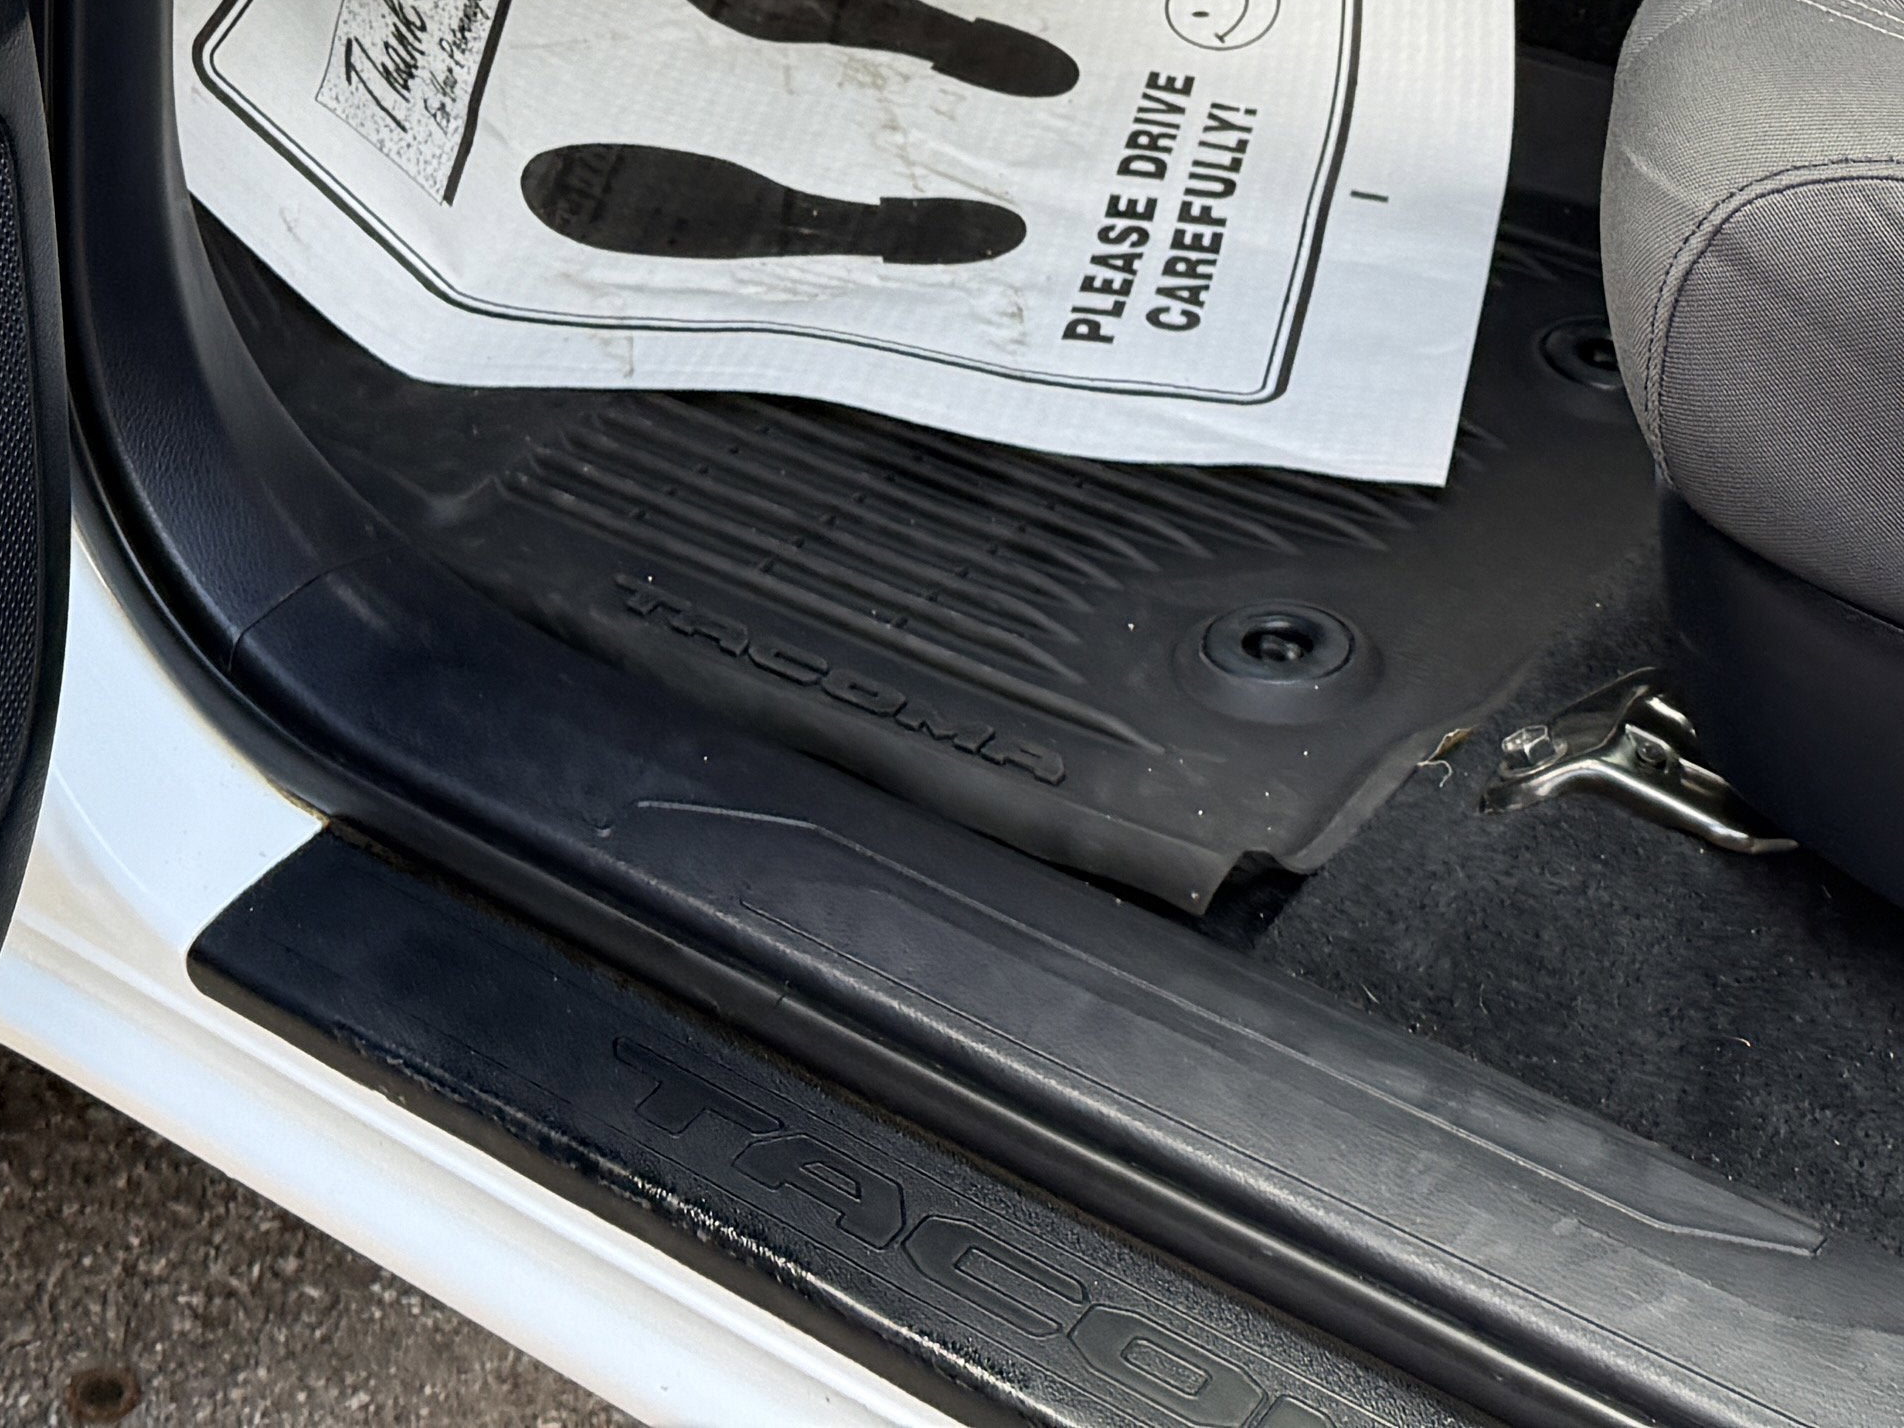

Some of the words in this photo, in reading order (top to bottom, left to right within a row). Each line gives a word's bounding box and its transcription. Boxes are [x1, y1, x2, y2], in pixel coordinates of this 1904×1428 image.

[1061, 193, 1159, 345] PLEASE
[1116, 70, 1196, 182] DRIVE
[1144, 101, 1258, 332] CAREFULLY!
[611, 571, 1071, 787] TACOMA
[611, 1034, 1338, 1428] TACO
